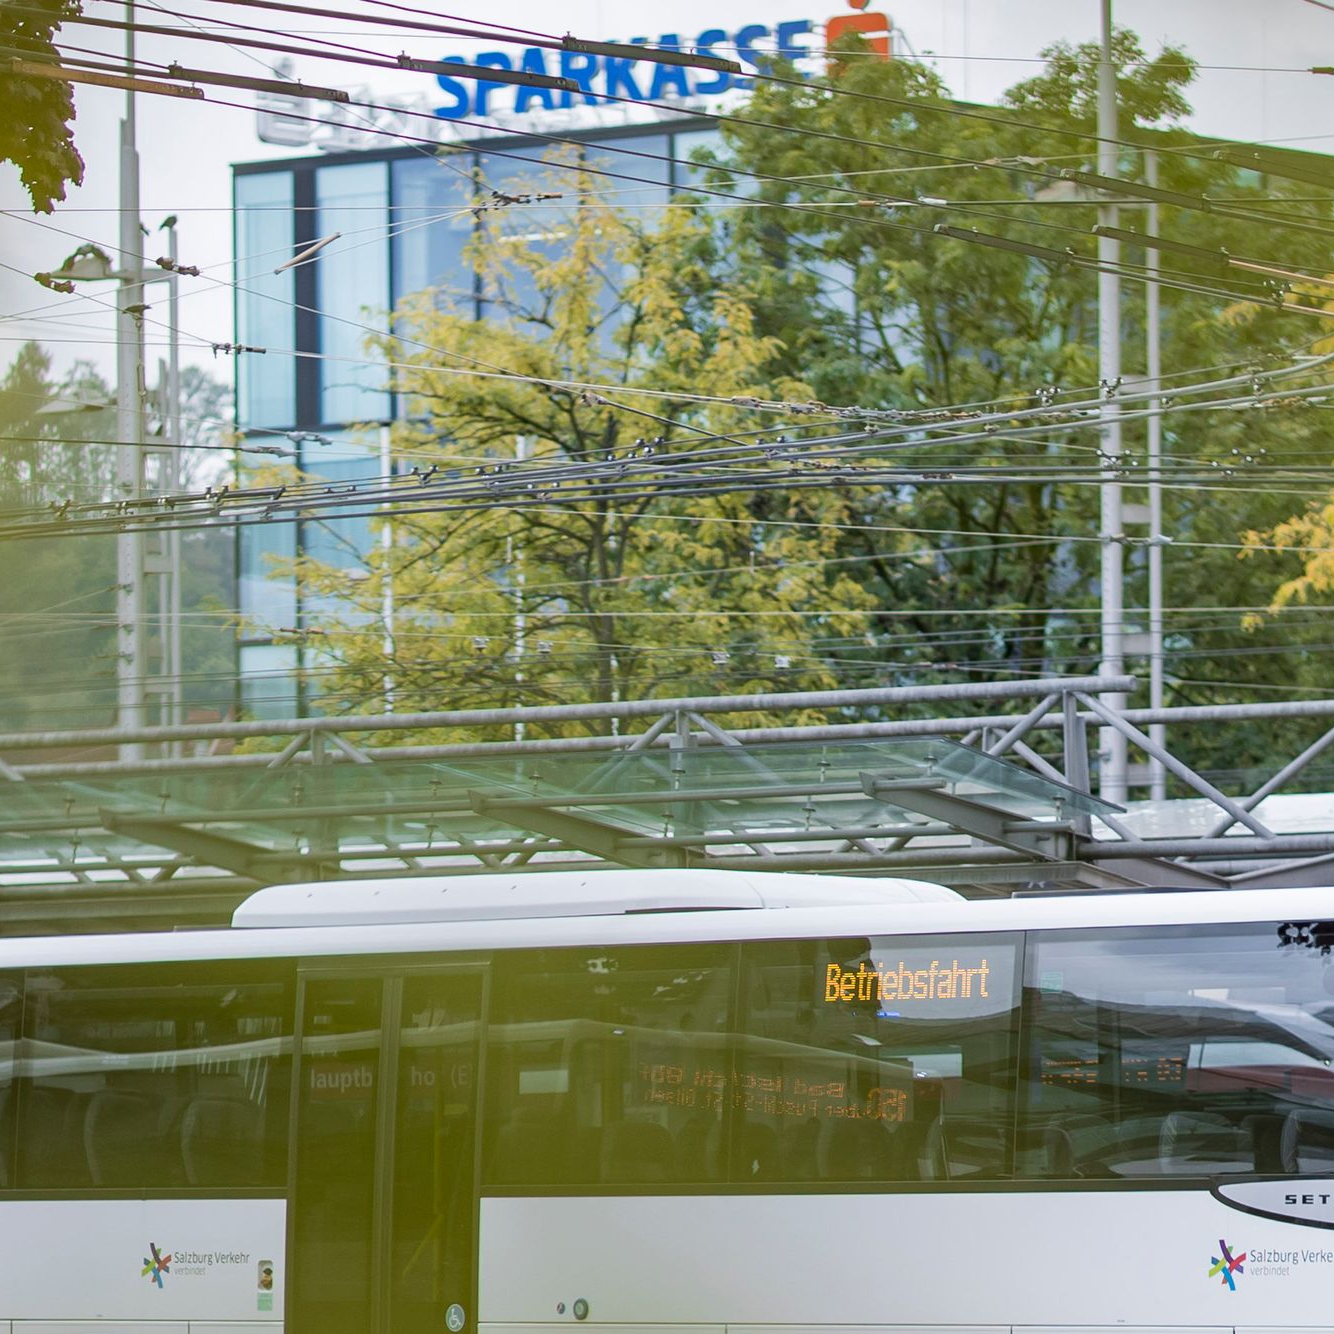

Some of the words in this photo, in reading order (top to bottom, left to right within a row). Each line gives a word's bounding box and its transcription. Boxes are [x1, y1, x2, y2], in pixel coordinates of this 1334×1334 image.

[433, 19, 812, 119] SPARKASSE
[825, 959, 990, 1002] Betriebsfahrt
[174, 1251, 213, 1266] Salzburg
[214, 1251, 251, 1264] Verkehr
[1250, 1248, 1299, 1265] Salzburg
[1250, 1266, 1291, 1276] verbindet
